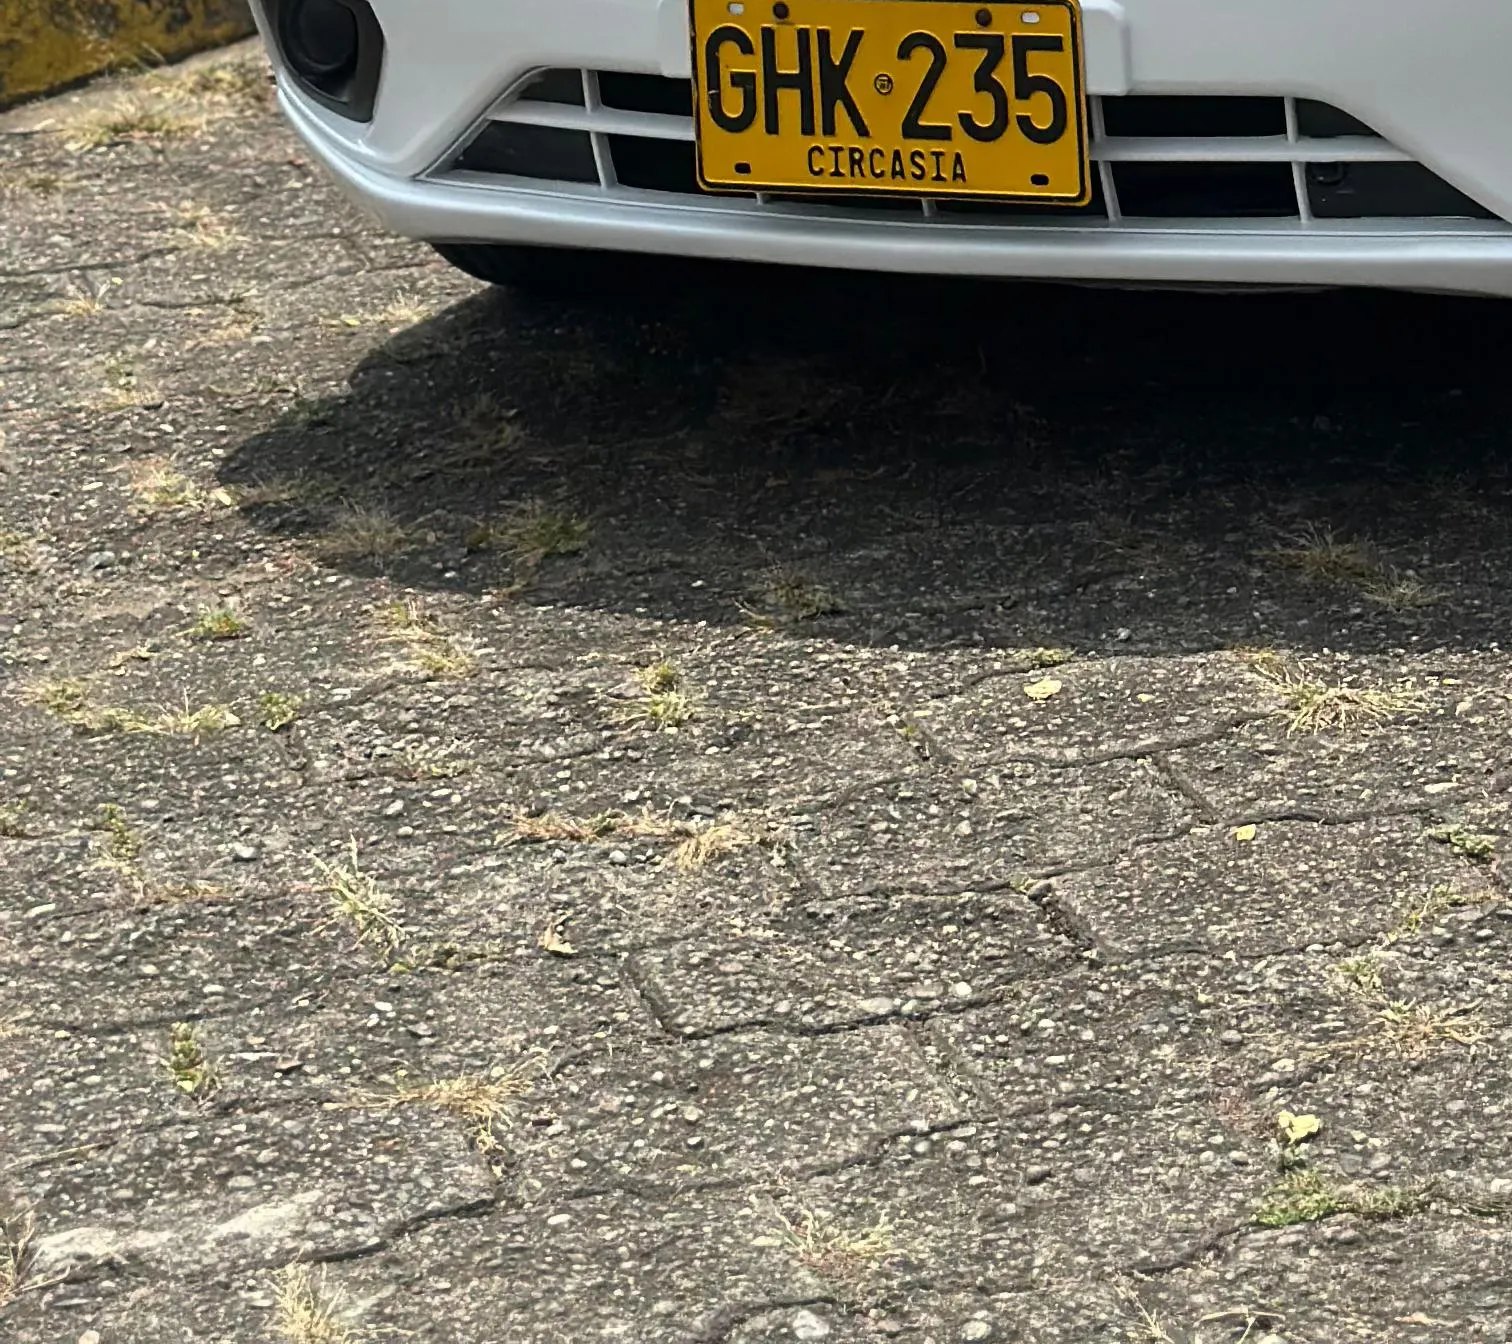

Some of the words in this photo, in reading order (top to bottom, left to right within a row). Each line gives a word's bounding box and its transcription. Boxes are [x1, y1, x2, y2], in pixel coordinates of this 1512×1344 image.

[705, 25, 870, 139] GHK
[896, 32, 1068, 145] 235
[807, 145, 968, 183] CIRCASIA
